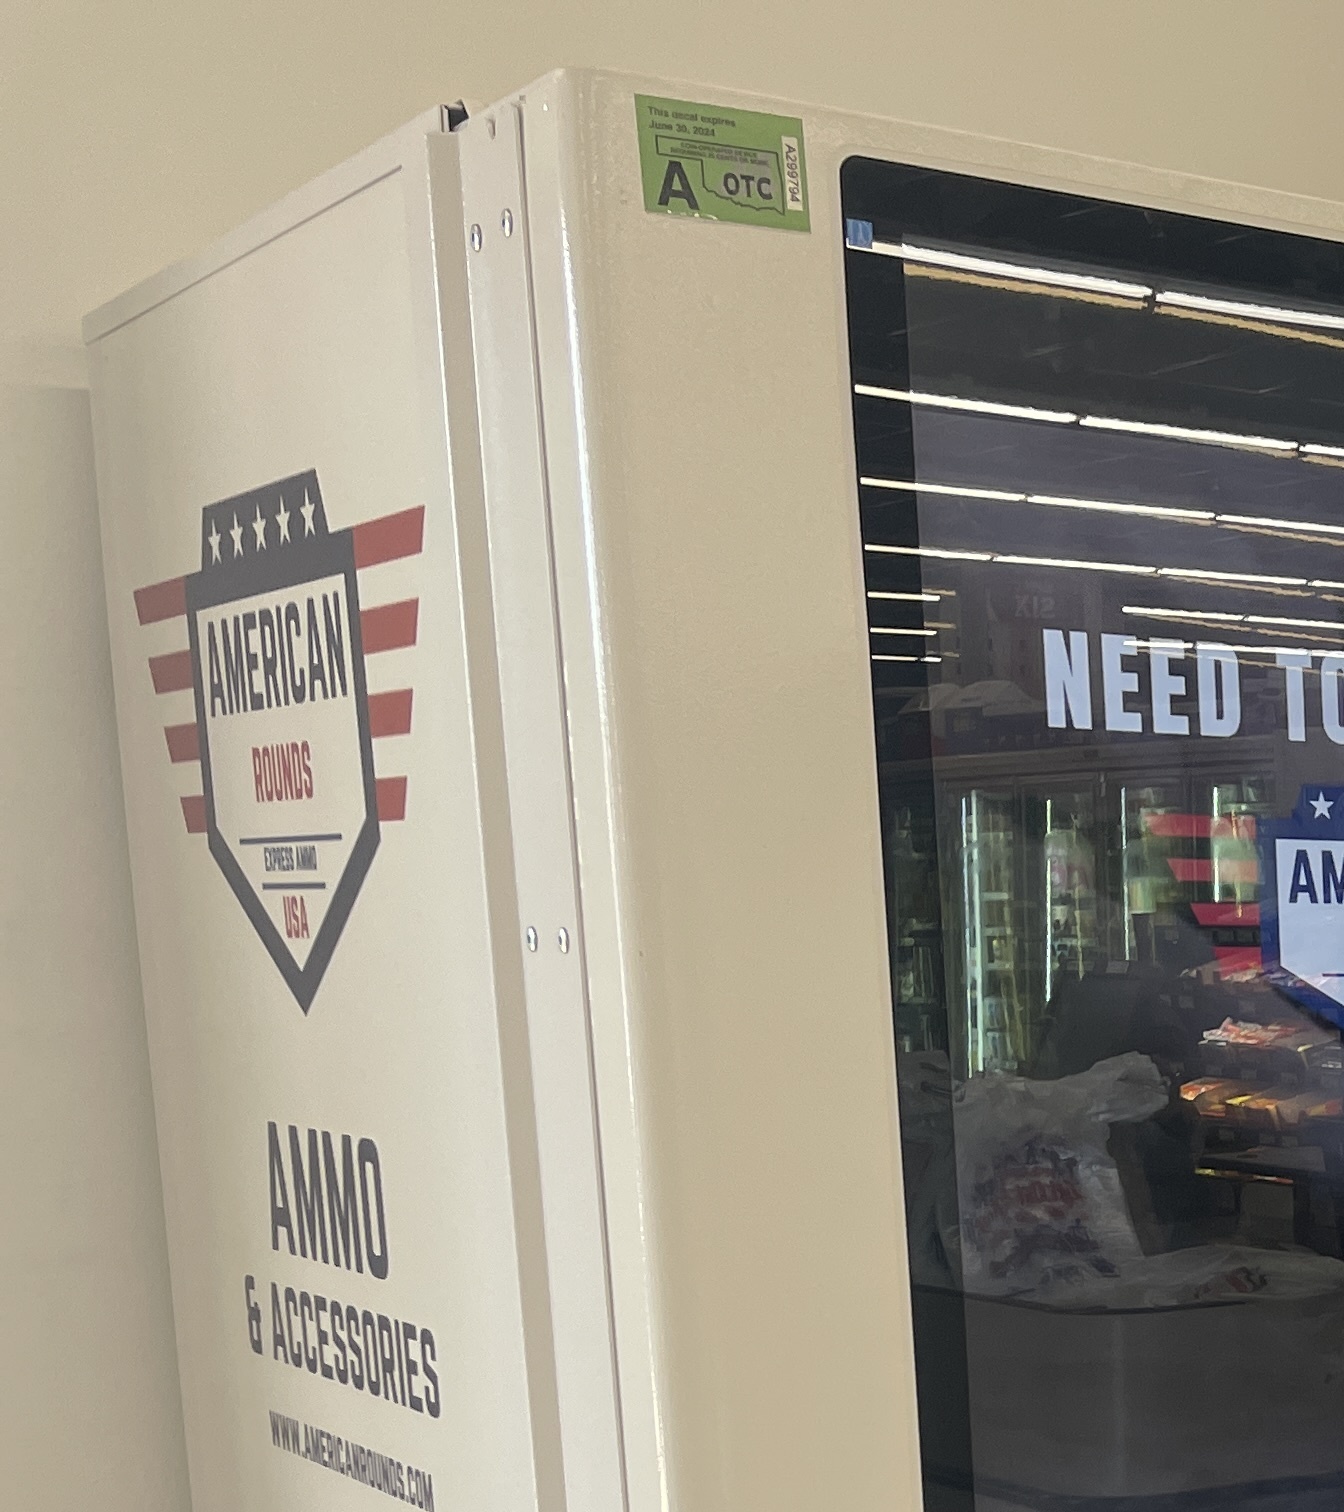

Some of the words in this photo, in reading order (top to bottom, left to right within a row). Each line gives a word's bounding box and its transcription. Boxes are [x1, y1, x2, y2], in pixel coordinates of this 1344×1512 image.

[647, 105, 670, 118] This
[700, 114, 736, 128] expires
[648, 120, 673, 131] June
[692, 126, 716, 137] 2024
[657, 159, 700, 211] A
[723, 172, 773, 201] OTC
[784, 142, 802, 203] A299794
[206, 590, 349, 719] AMERICAN
[1042, 627, 1242, 740] NEED
[251, 739, 314, 803] ROUNDS
[263, 848, 295, 873] EXPRESS
[295, 845, 318, 871] AMMO
[283, 895, 310, 939] USA
[267, 1120, 389, 1281] AMMO
[244, 1274, 263, 1357] &
[270, 1282, 441, 1420] ACCESSORIES
